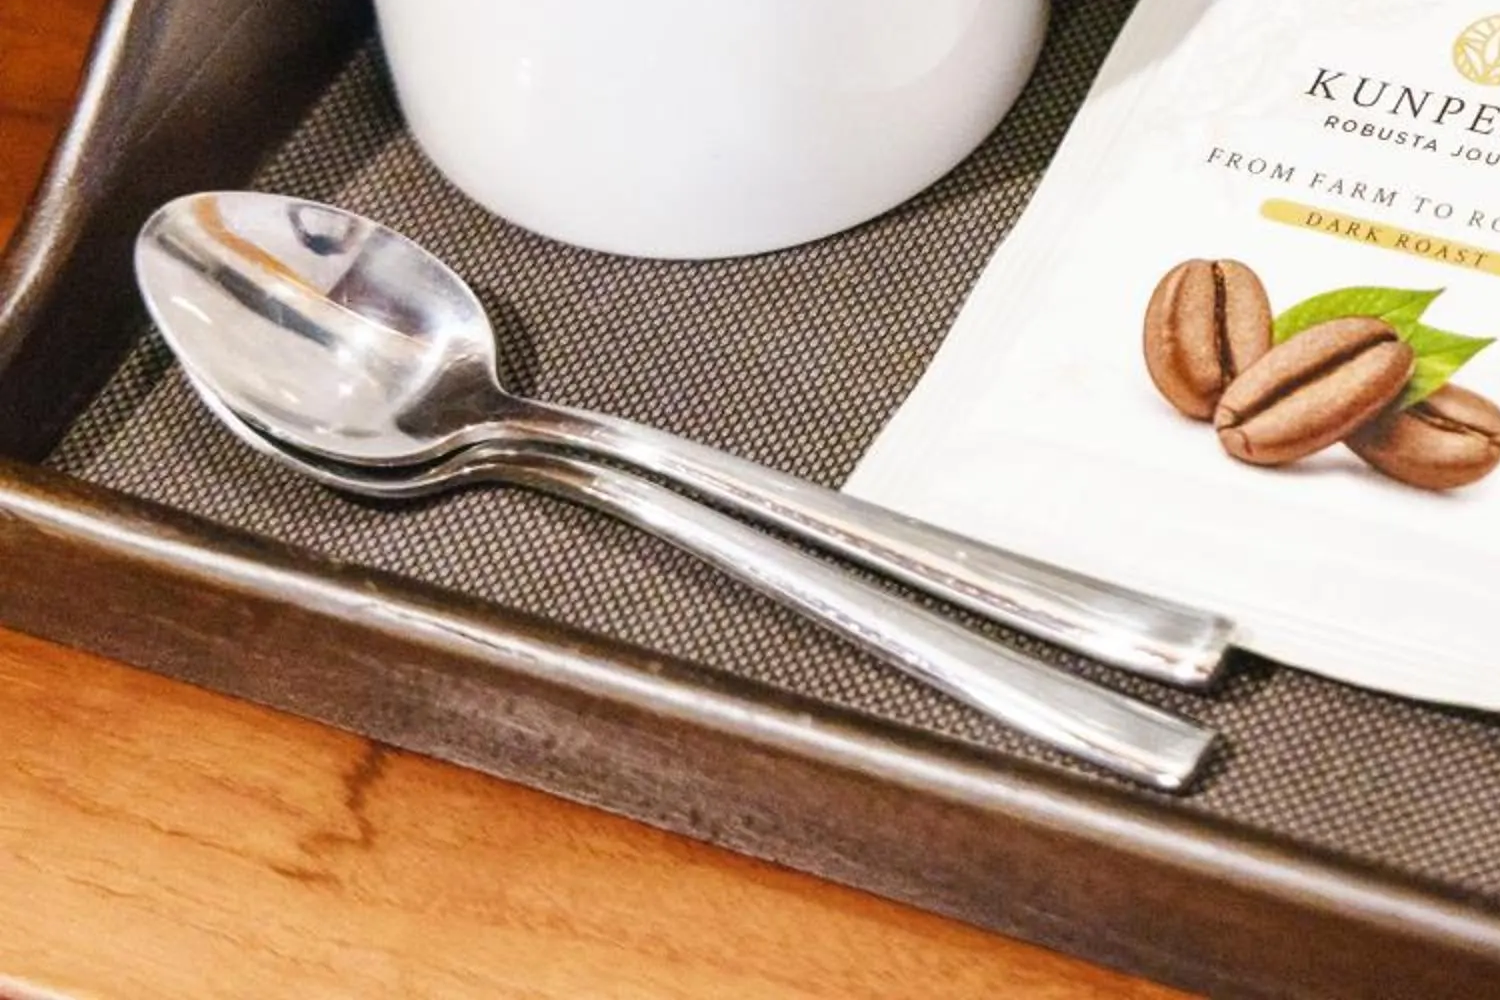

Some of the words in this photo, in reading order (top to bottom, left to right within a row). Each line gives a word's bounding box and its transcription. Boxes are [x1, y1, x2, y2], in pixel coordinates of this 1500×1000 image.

[1324, 114, 1439, 153] ROBUSTA
[1206, 146, 1297, 183] FROM
[1309, 172, 1397, 207] FARM
[1413, 196, 1454, 220] TO
[1305, 211, 1383, 243] DARK
[1396, 232, 1490, 268] ROAST
